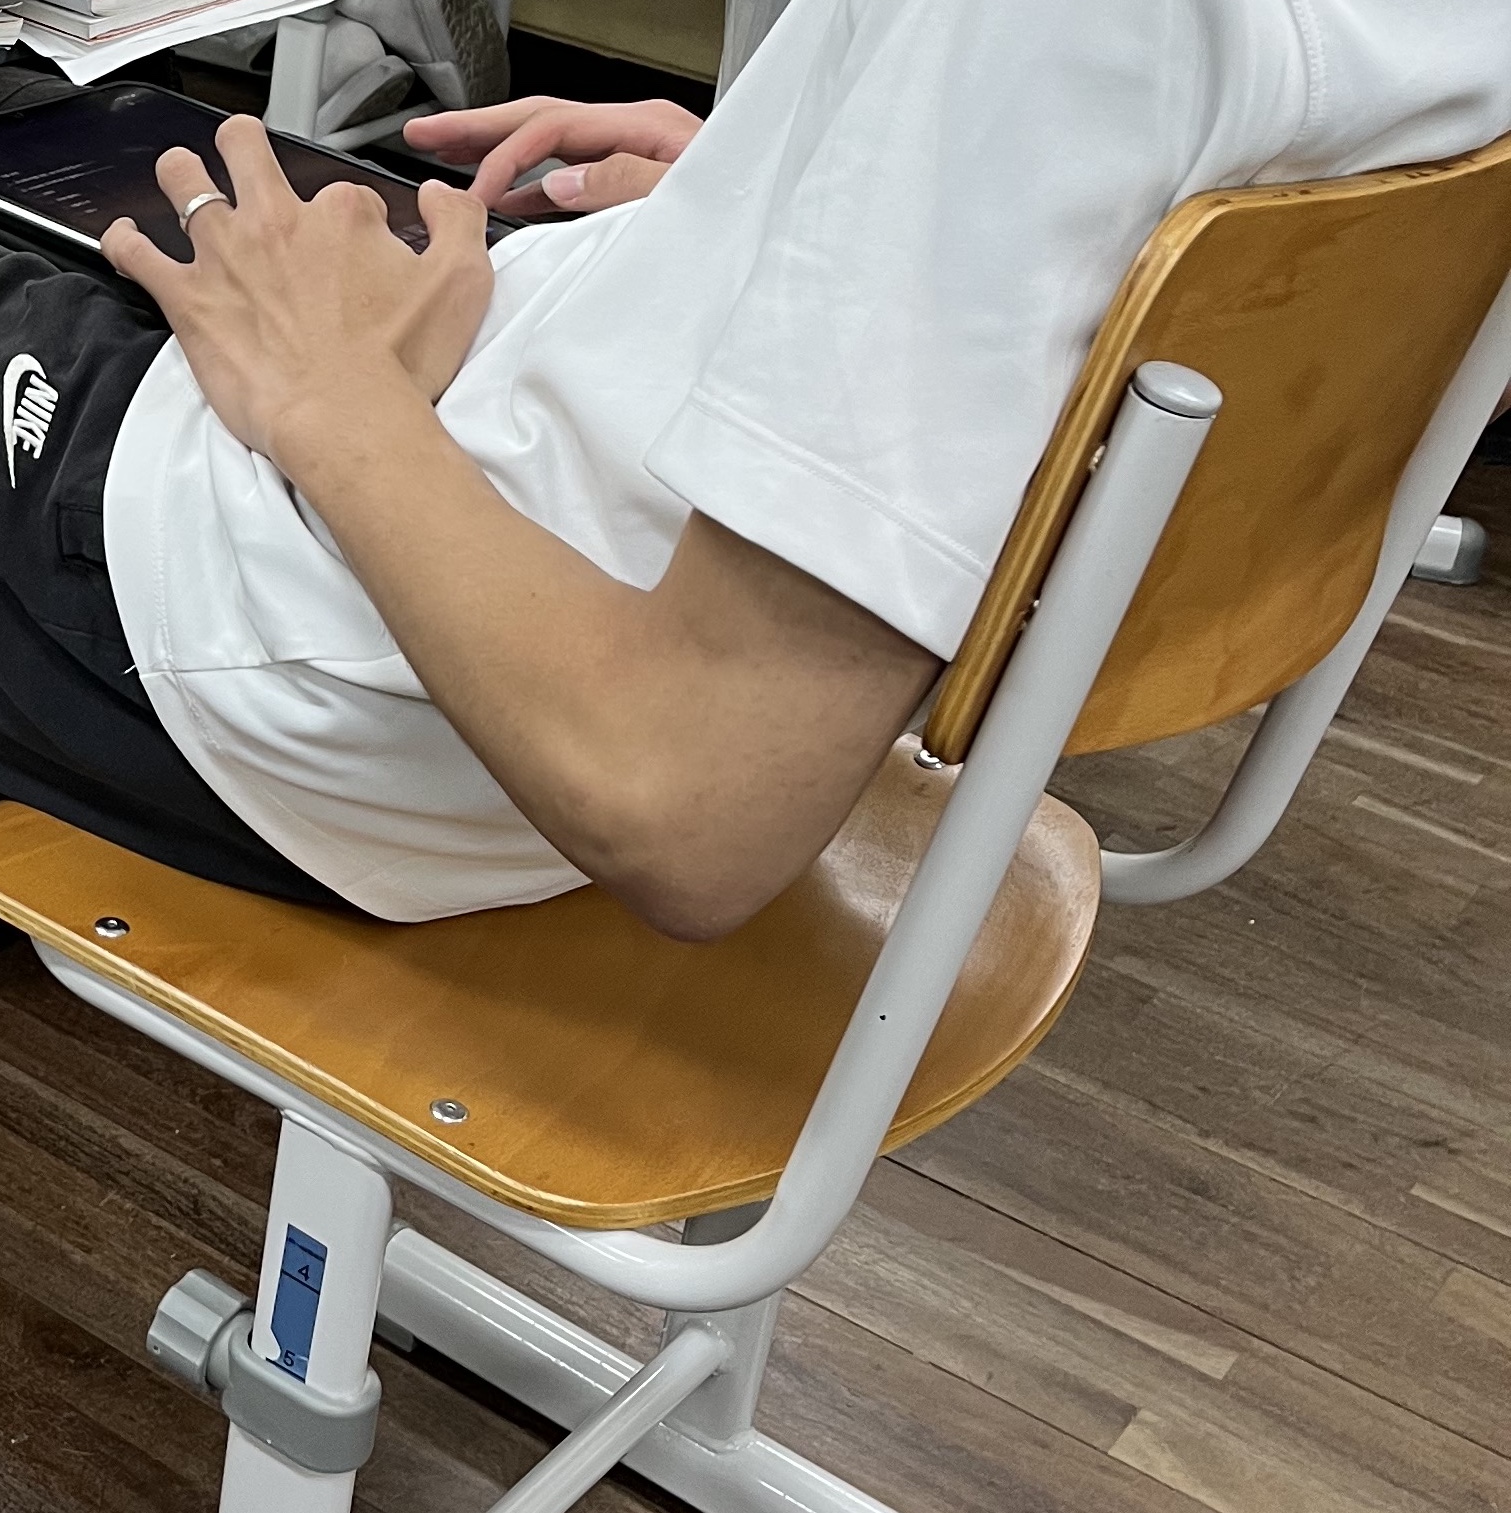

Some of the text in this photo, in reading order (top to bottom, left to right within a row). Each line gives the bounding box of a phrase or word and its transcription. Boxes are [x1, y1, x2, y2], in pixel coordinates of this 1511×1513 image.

[13, 373, 59, 460] NIKE
[297, 1264, 310, 1282] 4
[283, 1349, 296, 1367] 5
